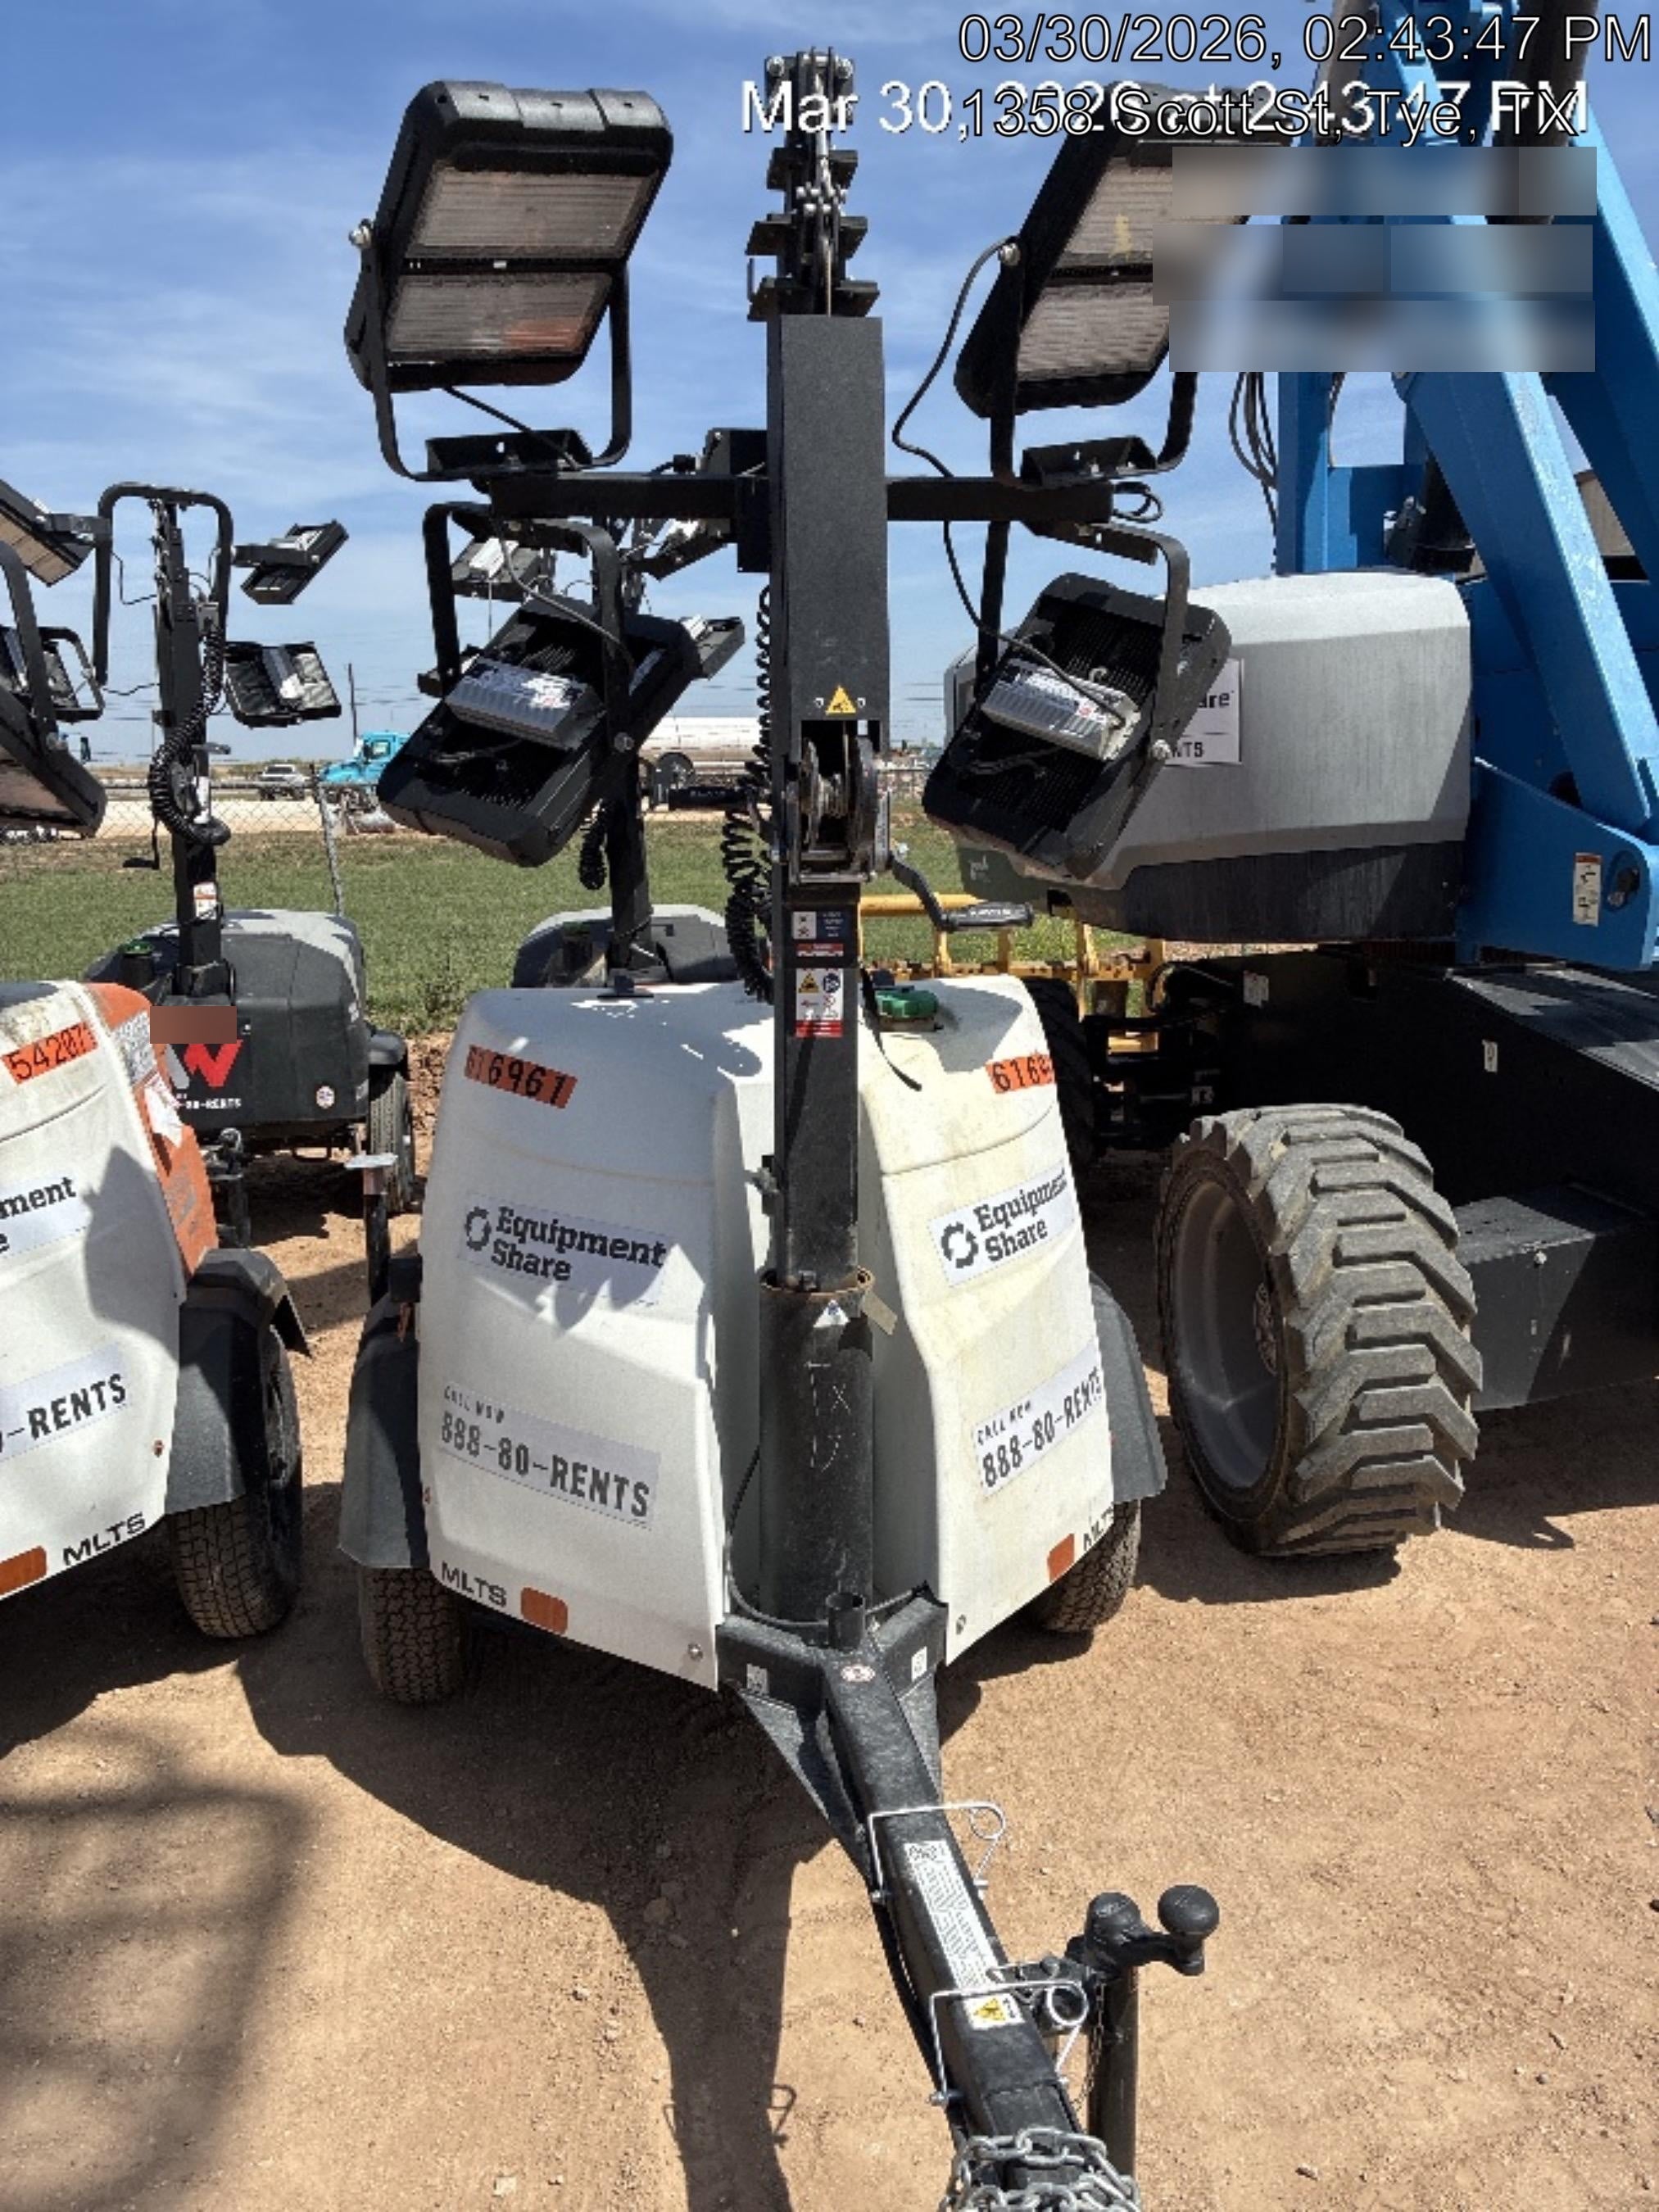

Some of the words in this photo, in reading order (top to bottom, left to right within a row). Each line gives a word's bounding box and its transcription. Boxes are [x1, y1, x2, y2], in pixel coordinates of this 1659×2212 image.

[973, 1166, 1067, 1232] Equipment
[492, 1239, 572, 1281] Share
[495, 1206, 667, 1269] Equipment
[985, 1219, 1048, 1262] Share
[442, 1411, 650, 1517] 888-80-RENTS
[62, 1512, 146, 1566] MLTS
[442, 1561, 507, 1607] MLTS
